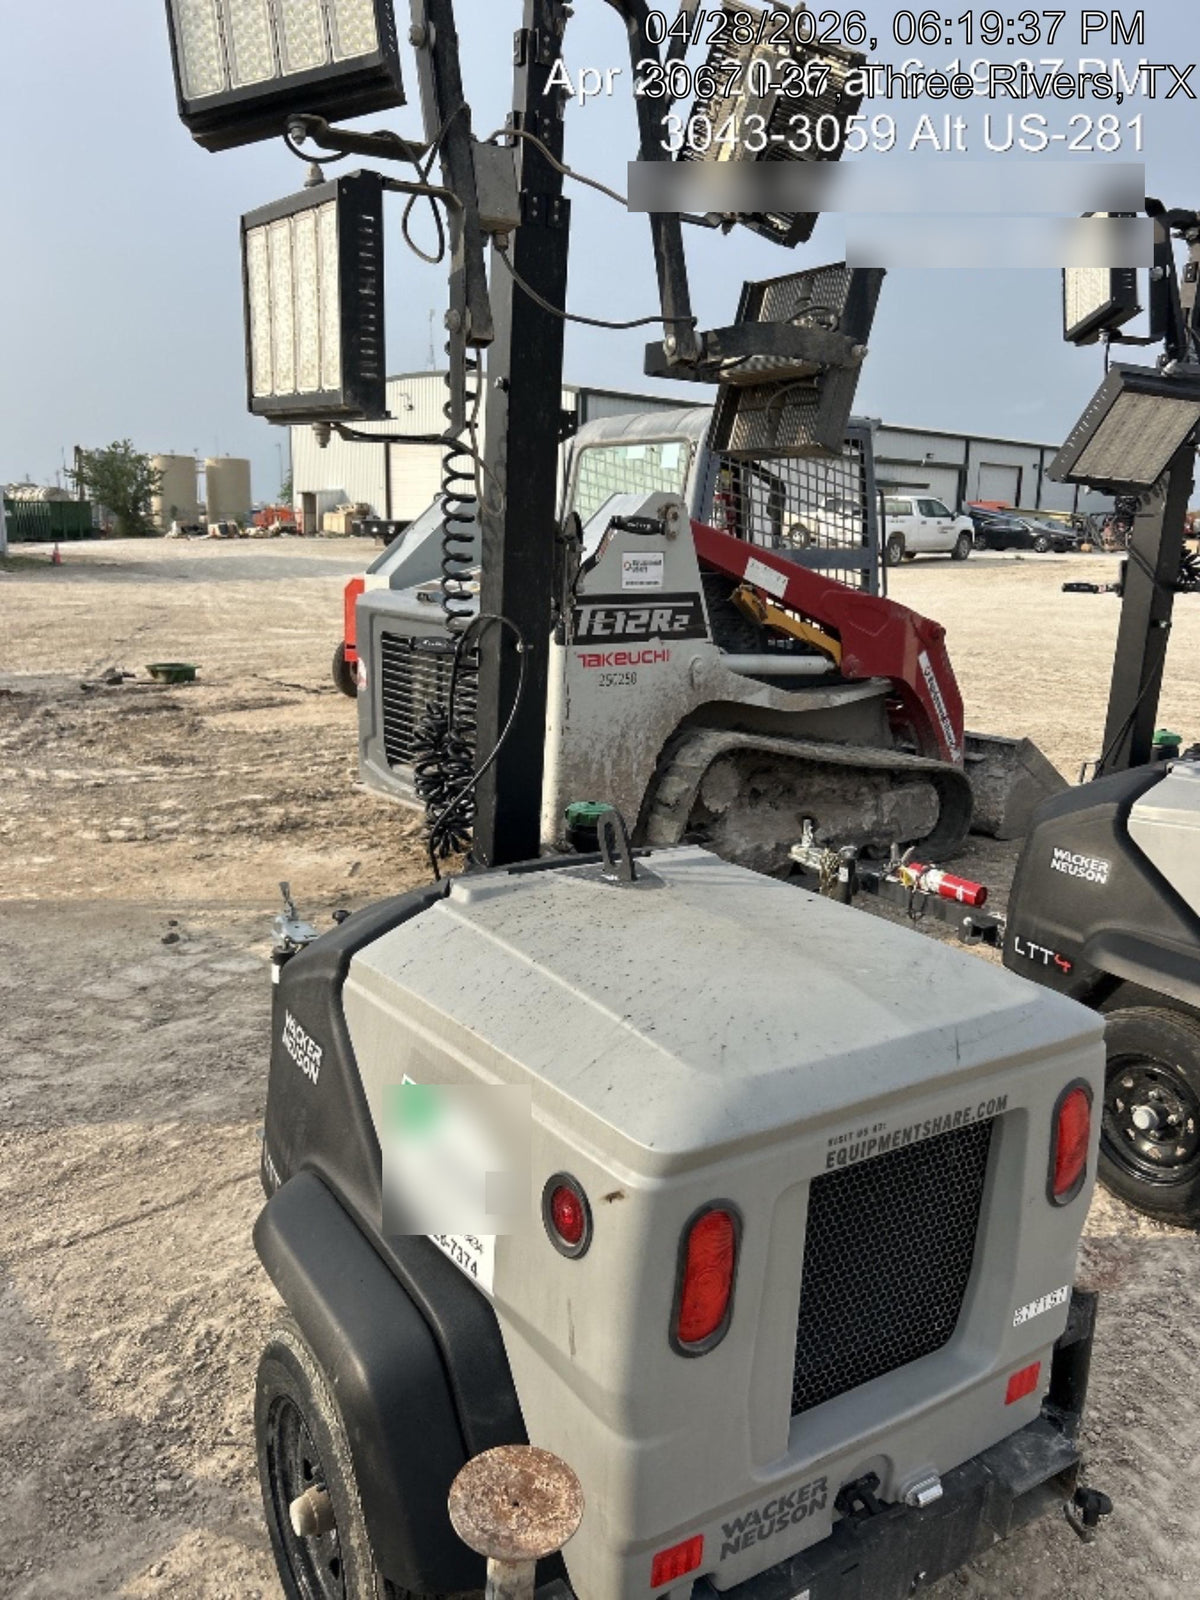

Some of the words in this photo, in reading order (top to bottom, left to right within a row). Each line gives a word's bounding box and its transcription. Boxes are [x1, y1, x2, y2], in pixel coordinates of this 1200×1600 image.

[1050, 858, 1108, 884] NEUSON
[1053, 847, 1109, 874] WACKER
[282, 1026, 320, 1086] NEUSON
[285, 1008, 323, 1068] WACKER
[825, 1094, 1009, 1170] EQUIPMENTSHARE.COM
[719, 1492, 828, 1561] NEUSON
[721, 1475, 829, 1539] WACKER
